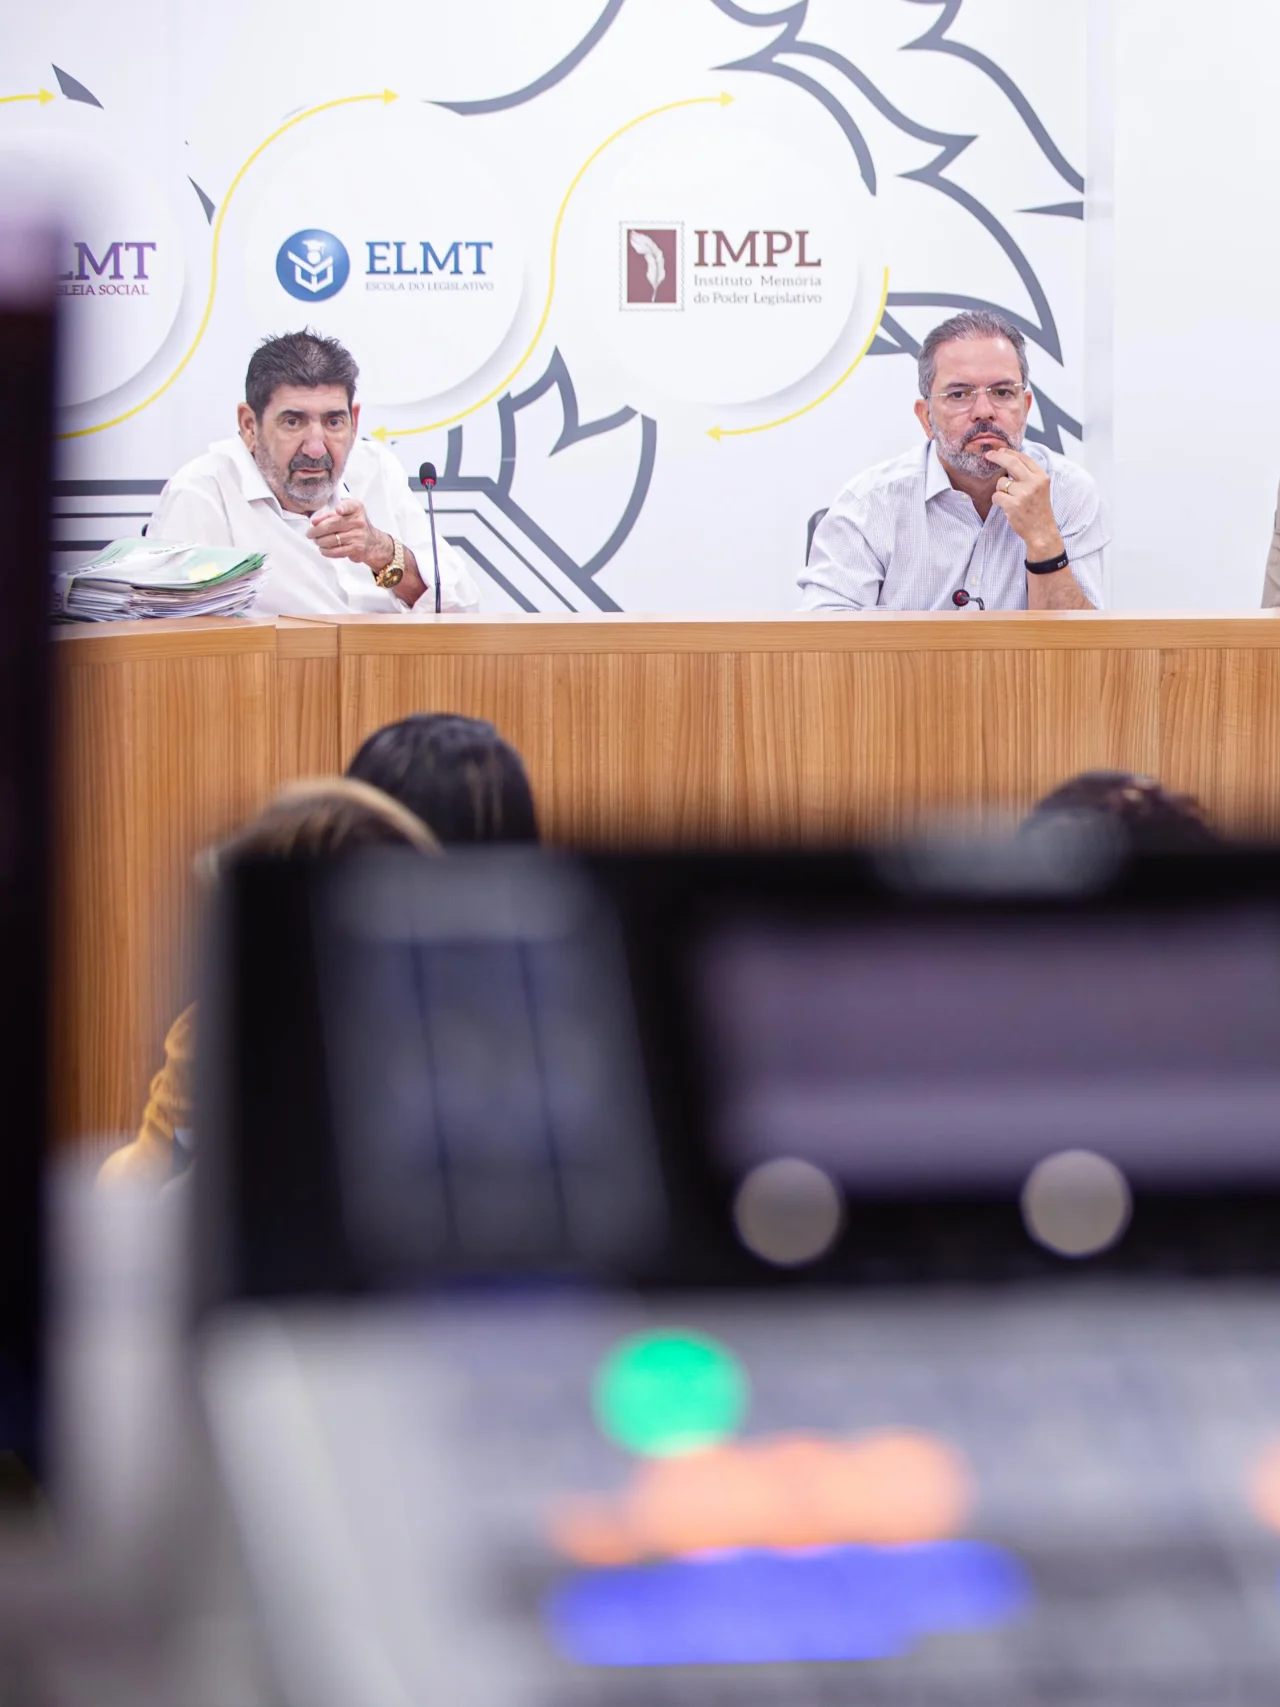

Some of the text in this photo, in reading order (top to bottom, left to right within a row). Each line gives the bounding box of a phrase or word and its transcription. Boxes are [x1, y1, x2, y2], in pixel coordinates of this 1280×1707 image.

[694, 230, 822, 267] IMPL
[365, 241, 493, 275] ELMT
[365, 282, 494, 291] ESCOLA DO LEGISLATIVO
[694, 274, 822, 287] Instituto Memória
[98, 284, 149, 296] SOCIAL
[693, 292, 822, 306] do Poder Legislativo
